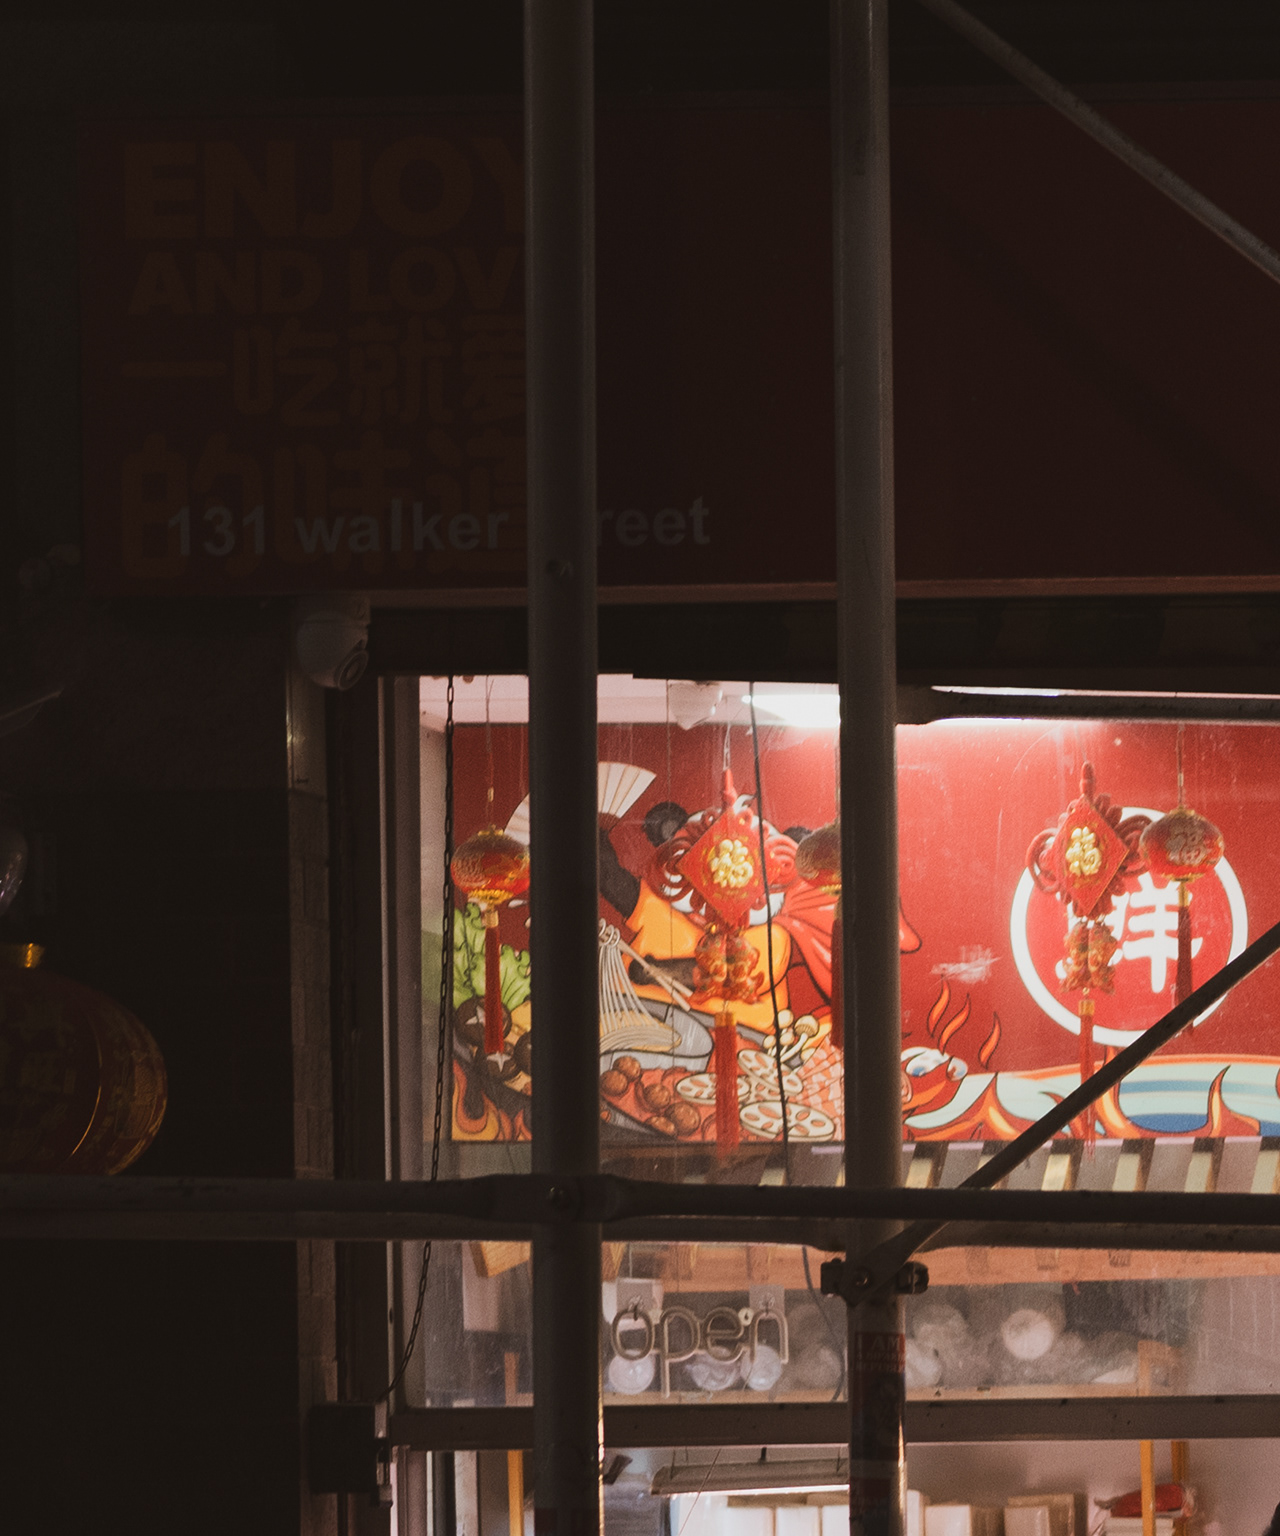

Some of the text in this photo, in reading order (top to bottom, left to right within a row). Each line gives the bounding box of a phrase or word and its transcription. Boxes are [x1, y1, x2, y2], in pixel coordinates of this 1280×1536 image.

[127, 246, 527, 315] AND LOV
[166, 496, 711, 557] 131 walker reet
